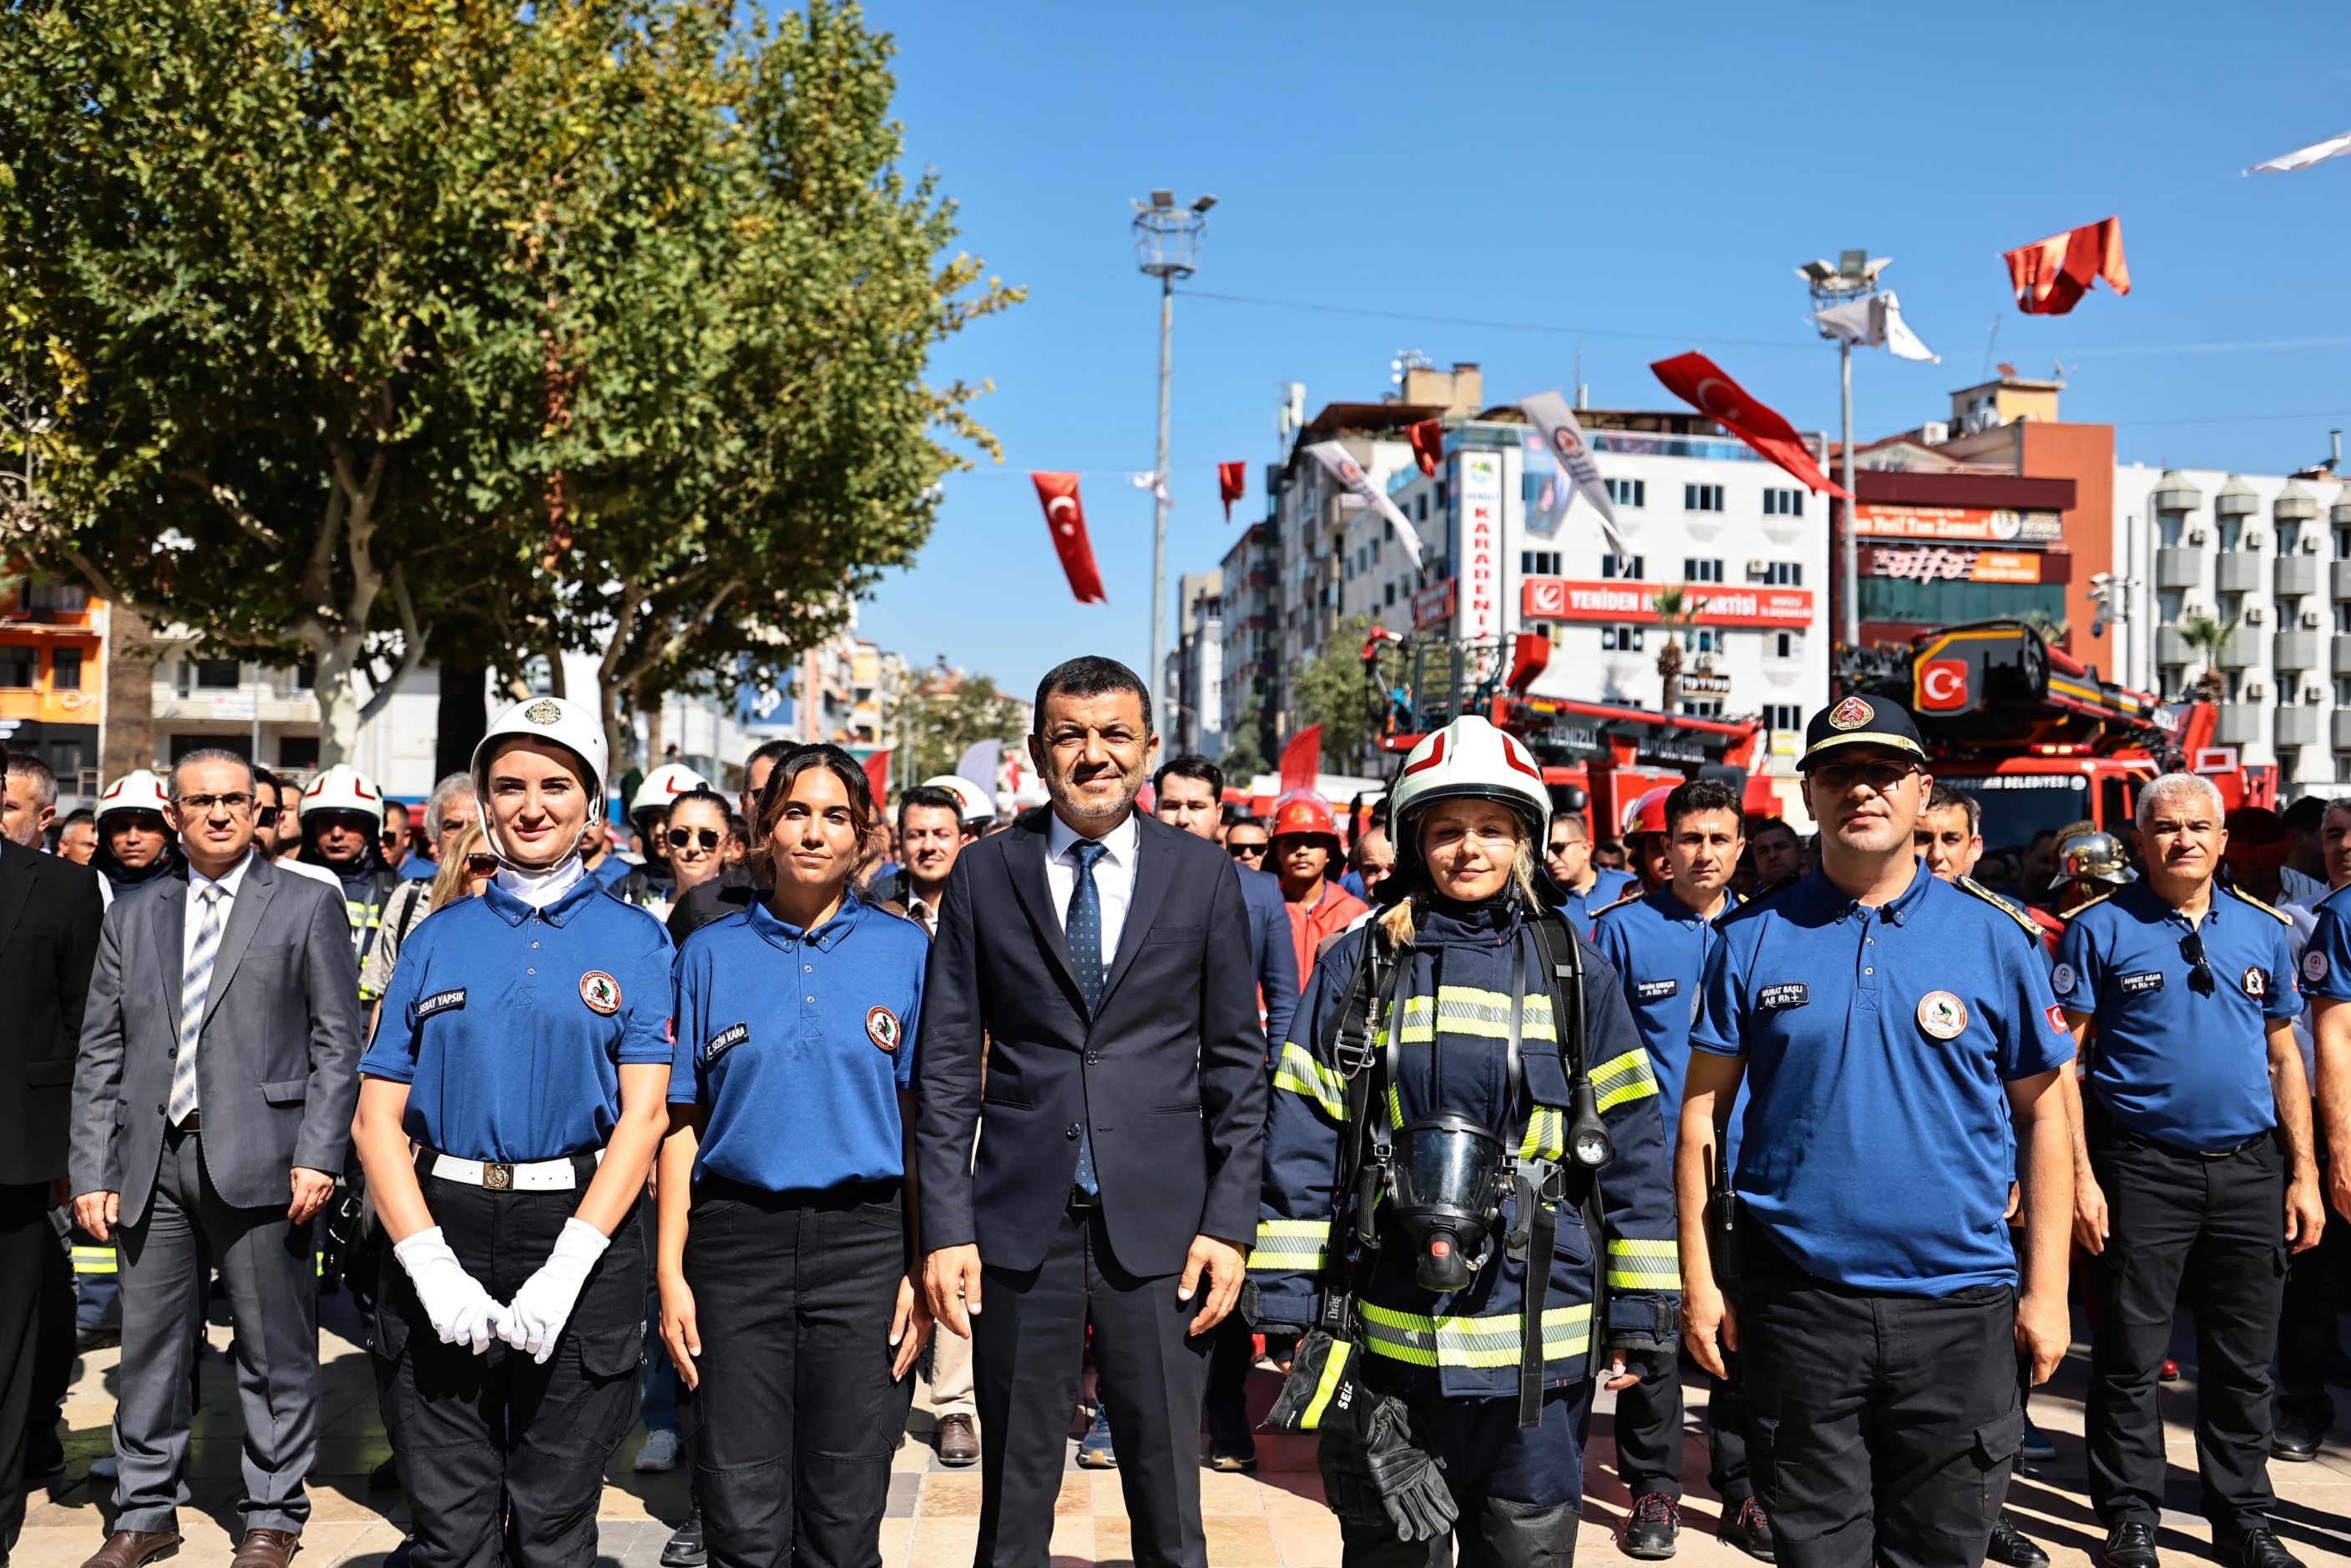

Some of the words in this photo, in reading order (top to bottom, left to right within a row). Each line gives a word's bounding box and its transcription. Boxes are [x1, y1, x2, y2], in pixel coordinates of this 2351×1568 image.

[1570, 588, 1639, 612] YENİDEN
[1762, 987, 1782, 998] MURAT
[1783, 985, 1802, 994] BAŞLI
[418, 997, 437, 1014] SERAY
[437, 991, 464, 1006] YAPSIK
[1765, 996, 1776, 1006] AB
[726, 1026, 746, 1042] KARA
